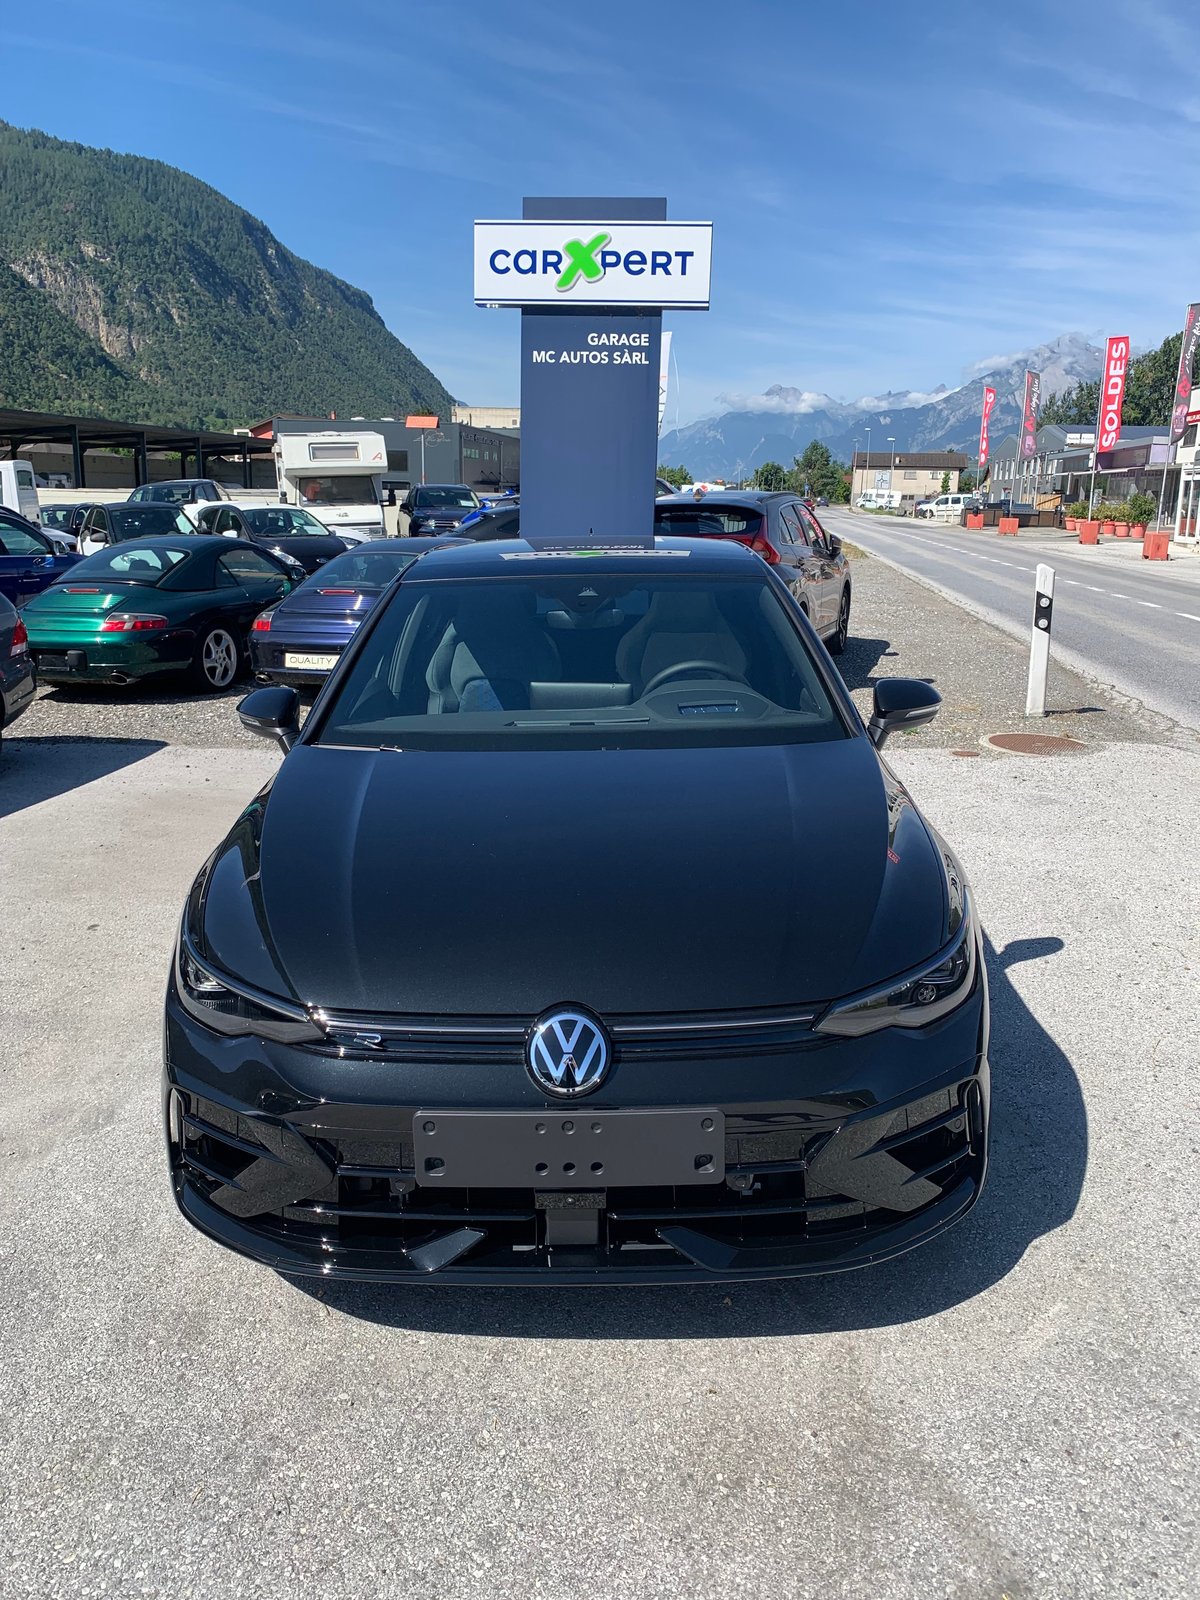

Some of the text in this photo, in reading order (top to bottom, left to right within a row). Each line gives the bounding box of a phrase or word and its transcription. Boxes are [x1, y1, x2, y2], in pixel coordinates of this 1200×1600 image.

[587, 333, 650, 346] GARAGE
[532, 348, 650, 365] MC AUTOS SÀRL
[1101, 341, 1127, 448] SOLDES
